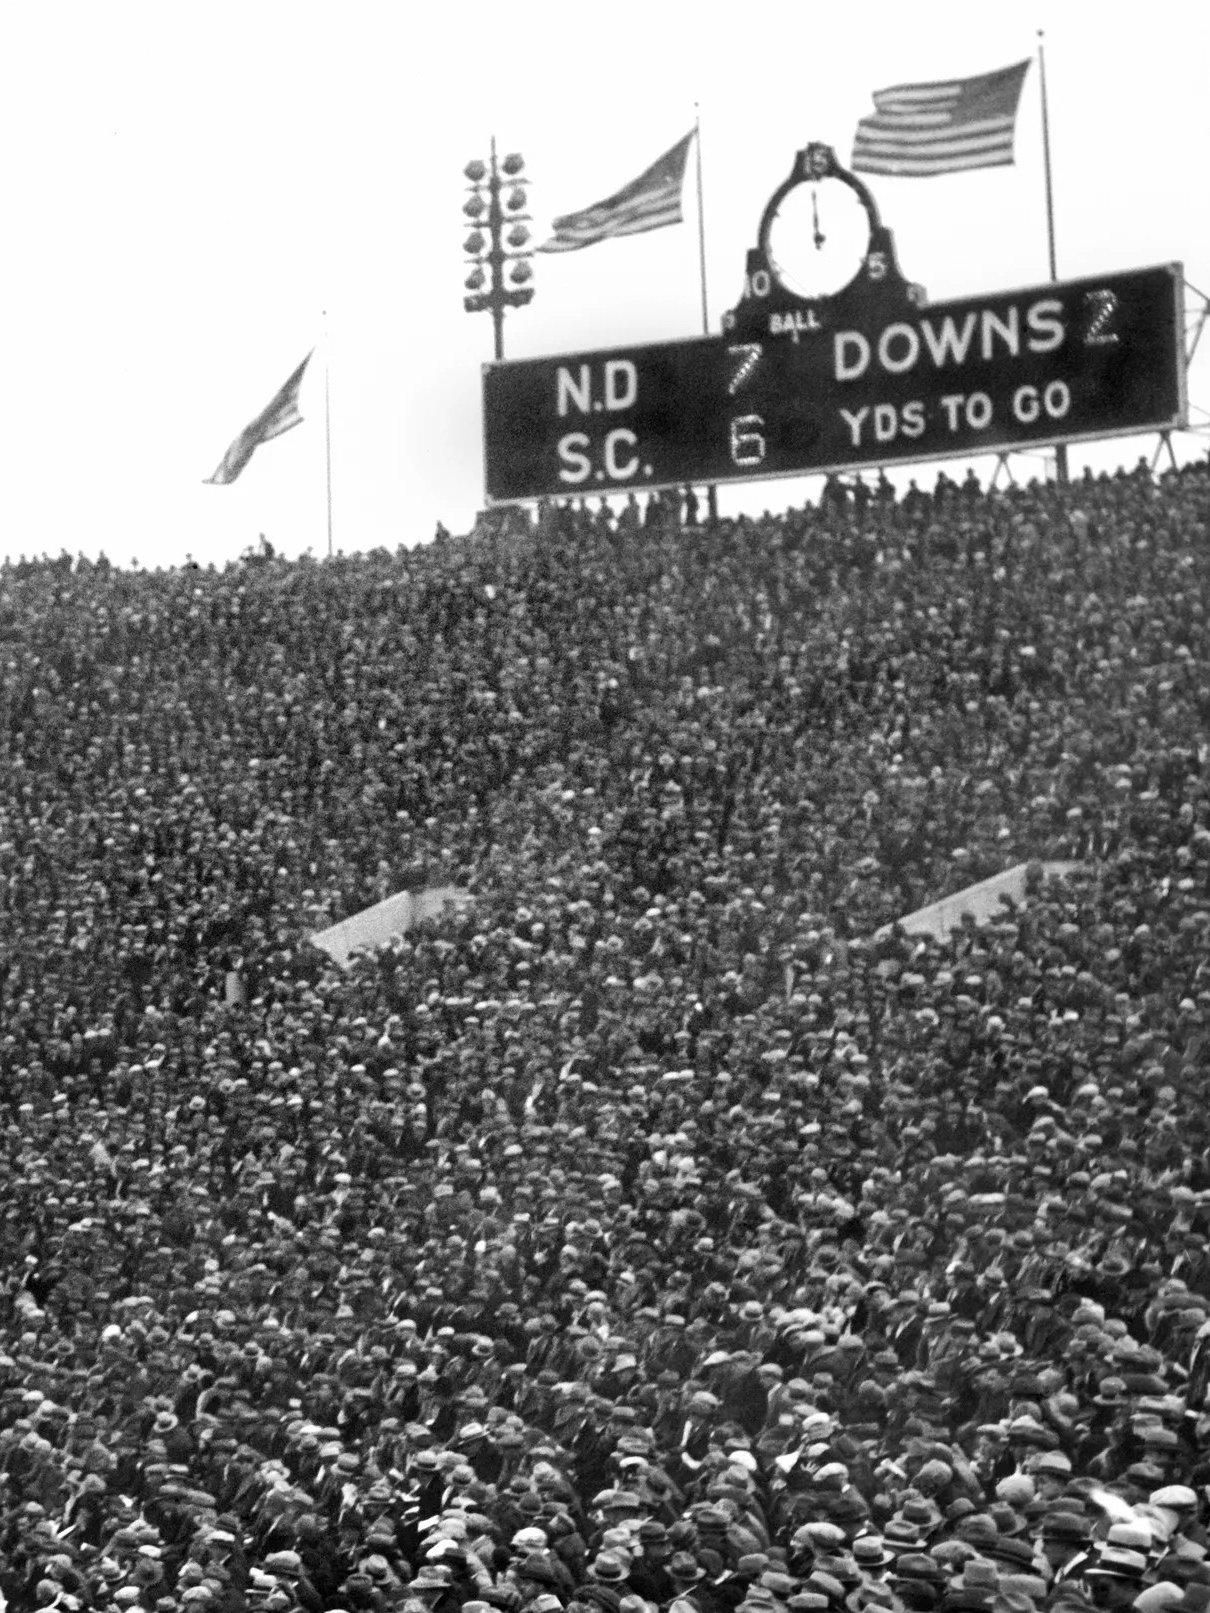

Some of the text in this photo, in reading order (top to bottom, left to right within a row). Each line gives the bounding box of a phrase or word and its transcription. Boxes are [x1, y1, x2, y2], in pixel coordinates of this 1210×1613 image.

[869, 252, 886, 279] 5
[769, 309, 821, 334] BALL
[834, 288, 1119, 381] DOWNS 2
[557, 343, 762, 417] N.D 7
[840, 380, 1070, 446] YDS TO GO
[557, 413, 766, 483] S.C. 6
